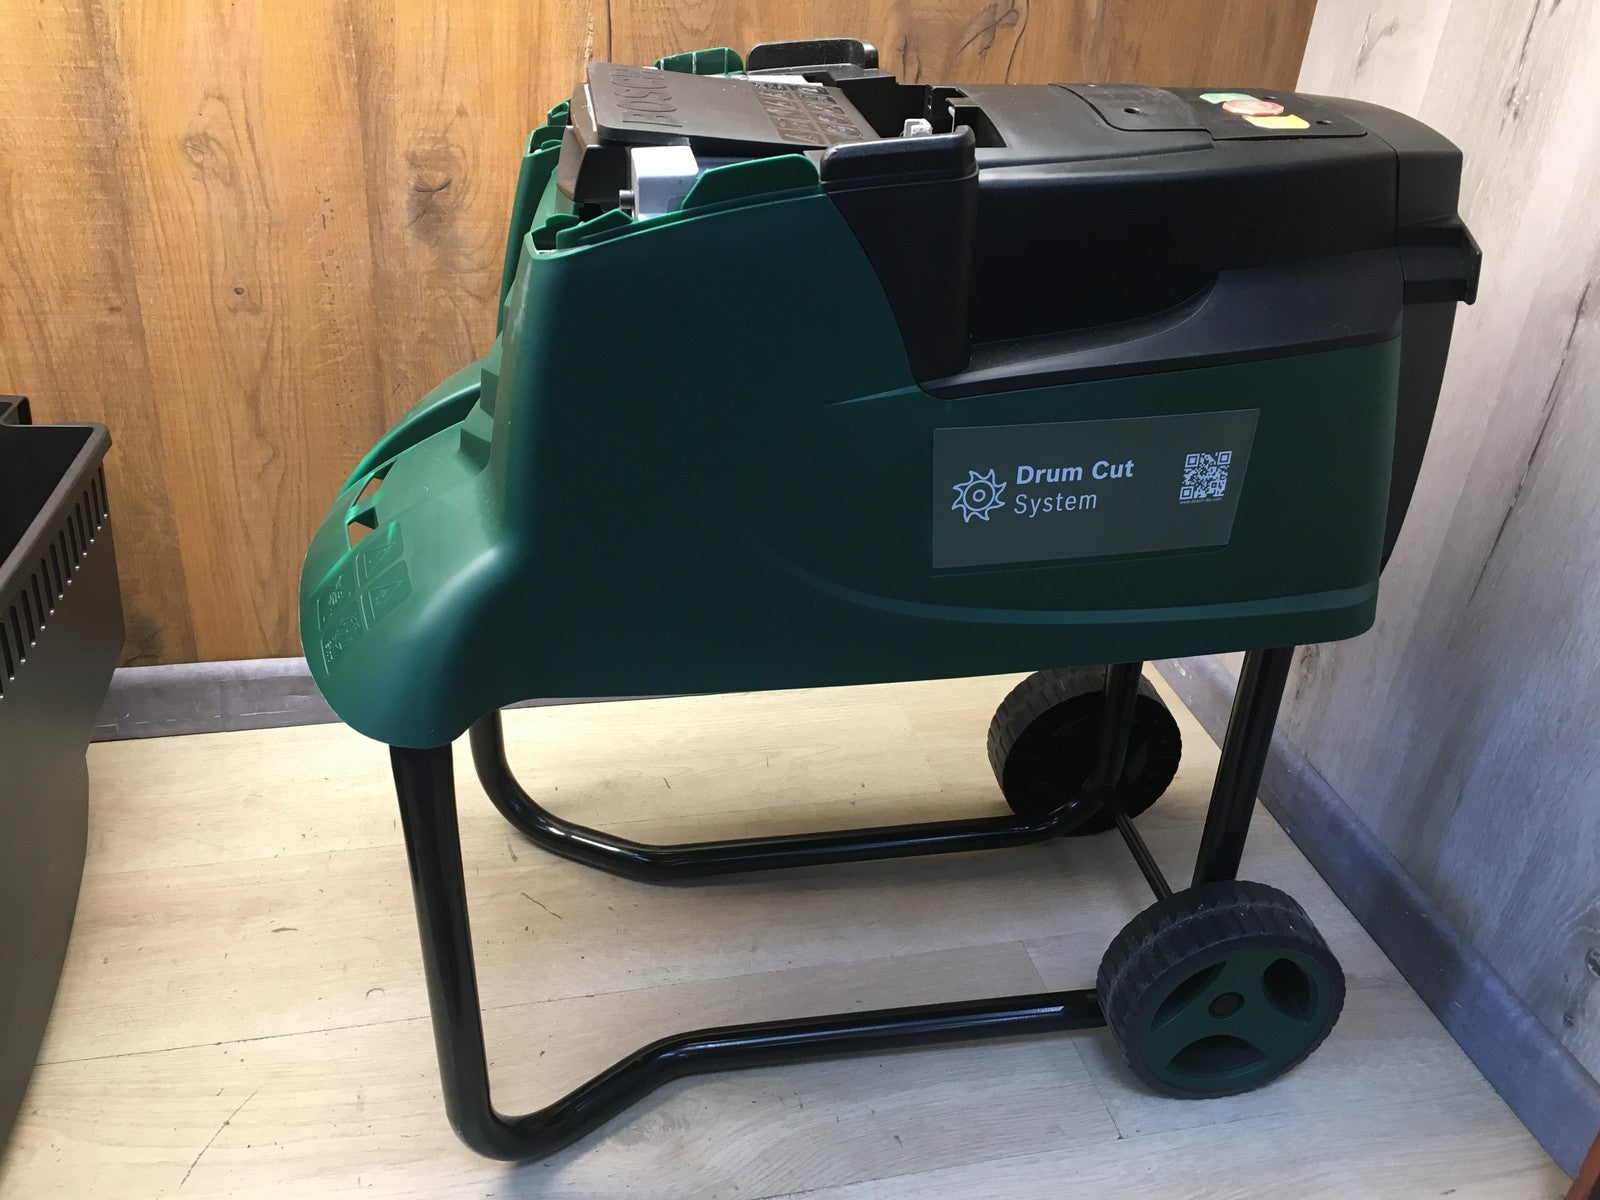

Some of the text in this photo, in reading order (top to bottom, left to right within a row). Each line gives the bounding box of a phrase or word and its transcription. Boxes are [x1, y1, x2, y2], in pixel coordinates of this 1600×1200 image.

[608, 67, 683, 128] BOSCH
[1016, 459, 1134, 485] Drum Cut
[1013, 492, 1097, 518] System
